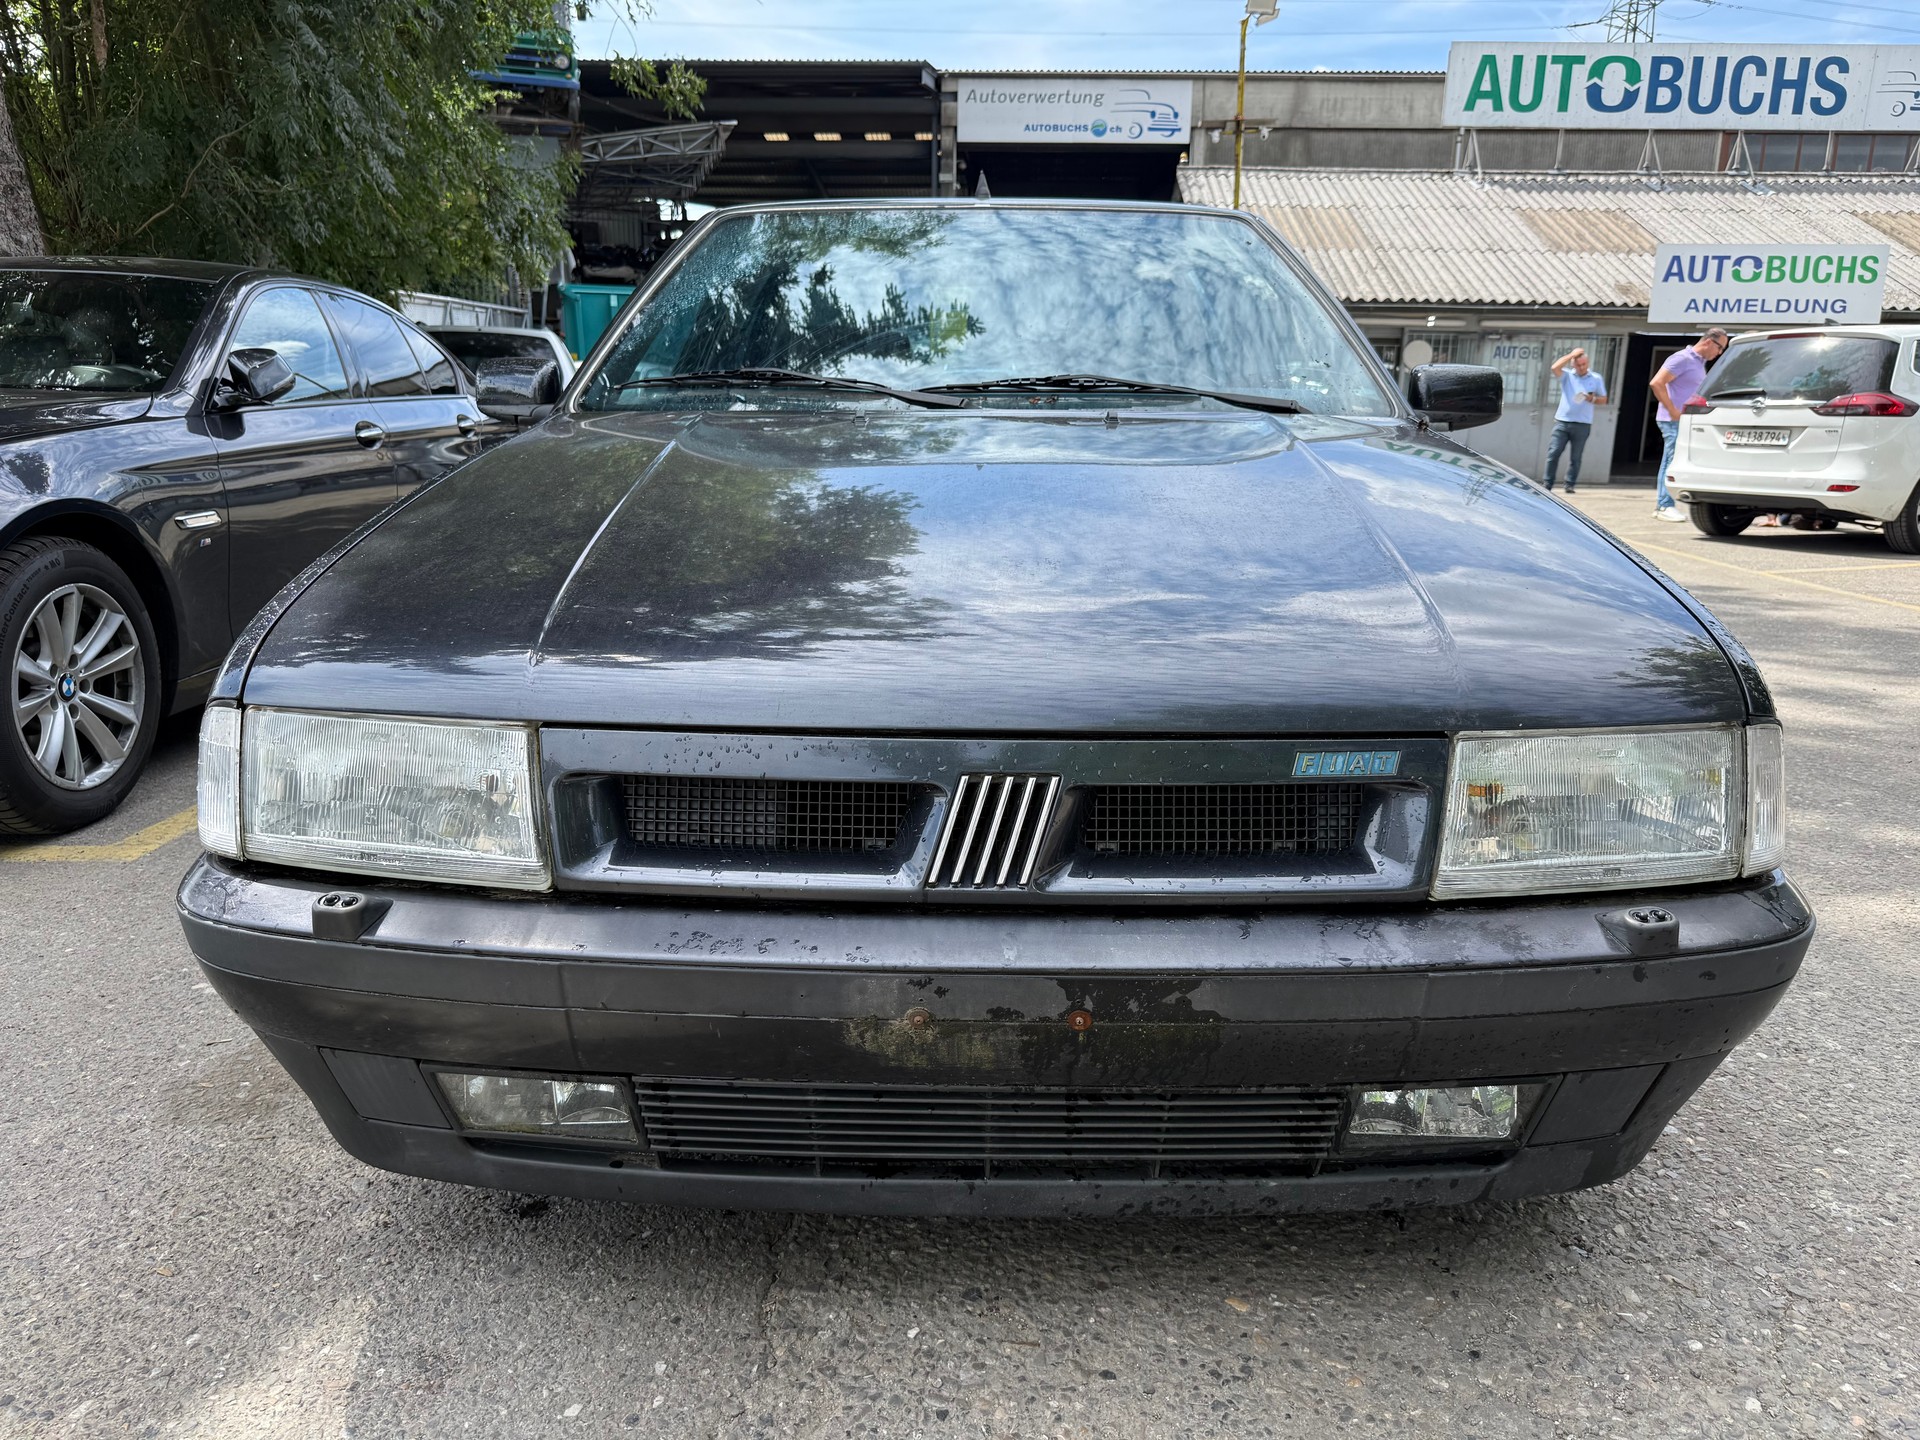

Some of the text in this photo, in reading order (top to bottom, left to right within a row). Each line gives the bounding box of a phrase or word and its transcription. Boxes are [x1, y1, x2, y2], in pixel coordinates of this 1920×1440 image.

[1462, 54, 1850, 116] AUTOBUCHS
[966, 89, 1105, 107] Autoverwertung
[1023, 123, 1089, 133] AUTOBUCHS
[1662, 254, 1879, 284] AUTOBUCHS
[1683, 298, 1848, 314] ANMELDUNG
[1300, 754, 1393, 773] FIAT
